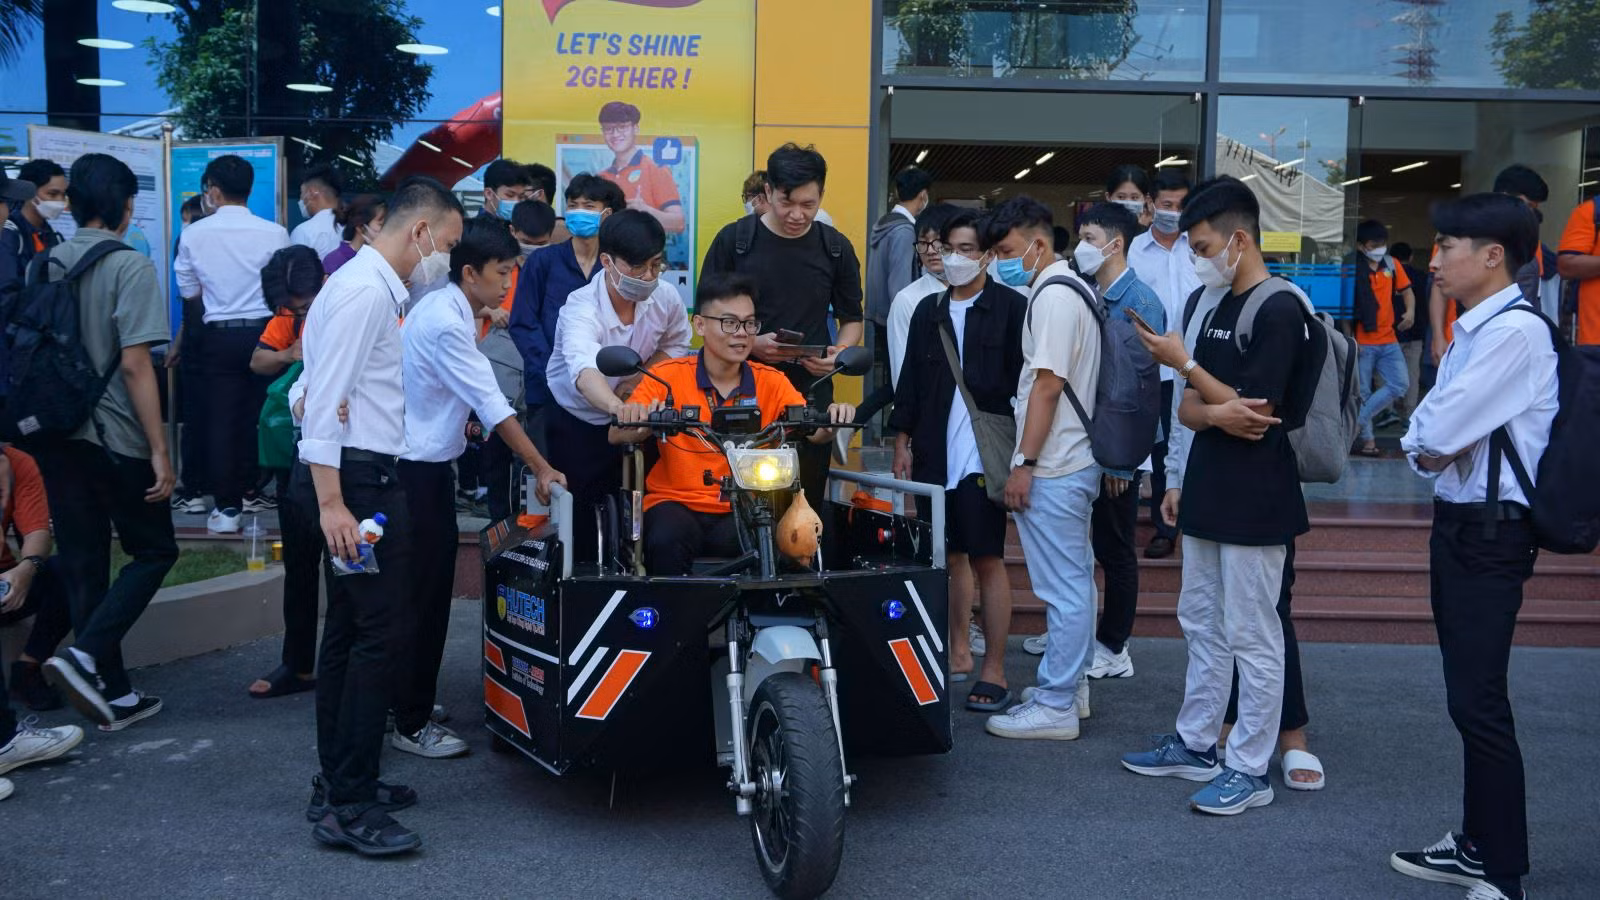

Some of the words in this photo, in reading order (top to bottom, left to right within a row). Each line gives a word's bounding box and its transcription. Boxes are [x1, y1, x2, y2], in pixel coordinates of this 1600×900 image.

[556, 32, 622, 56] LET'S
[628, 34, 701, 57] SHINE
[565, 65, 678, 90] 2GETHER
[507, 586, 545, 623] HUTECH
